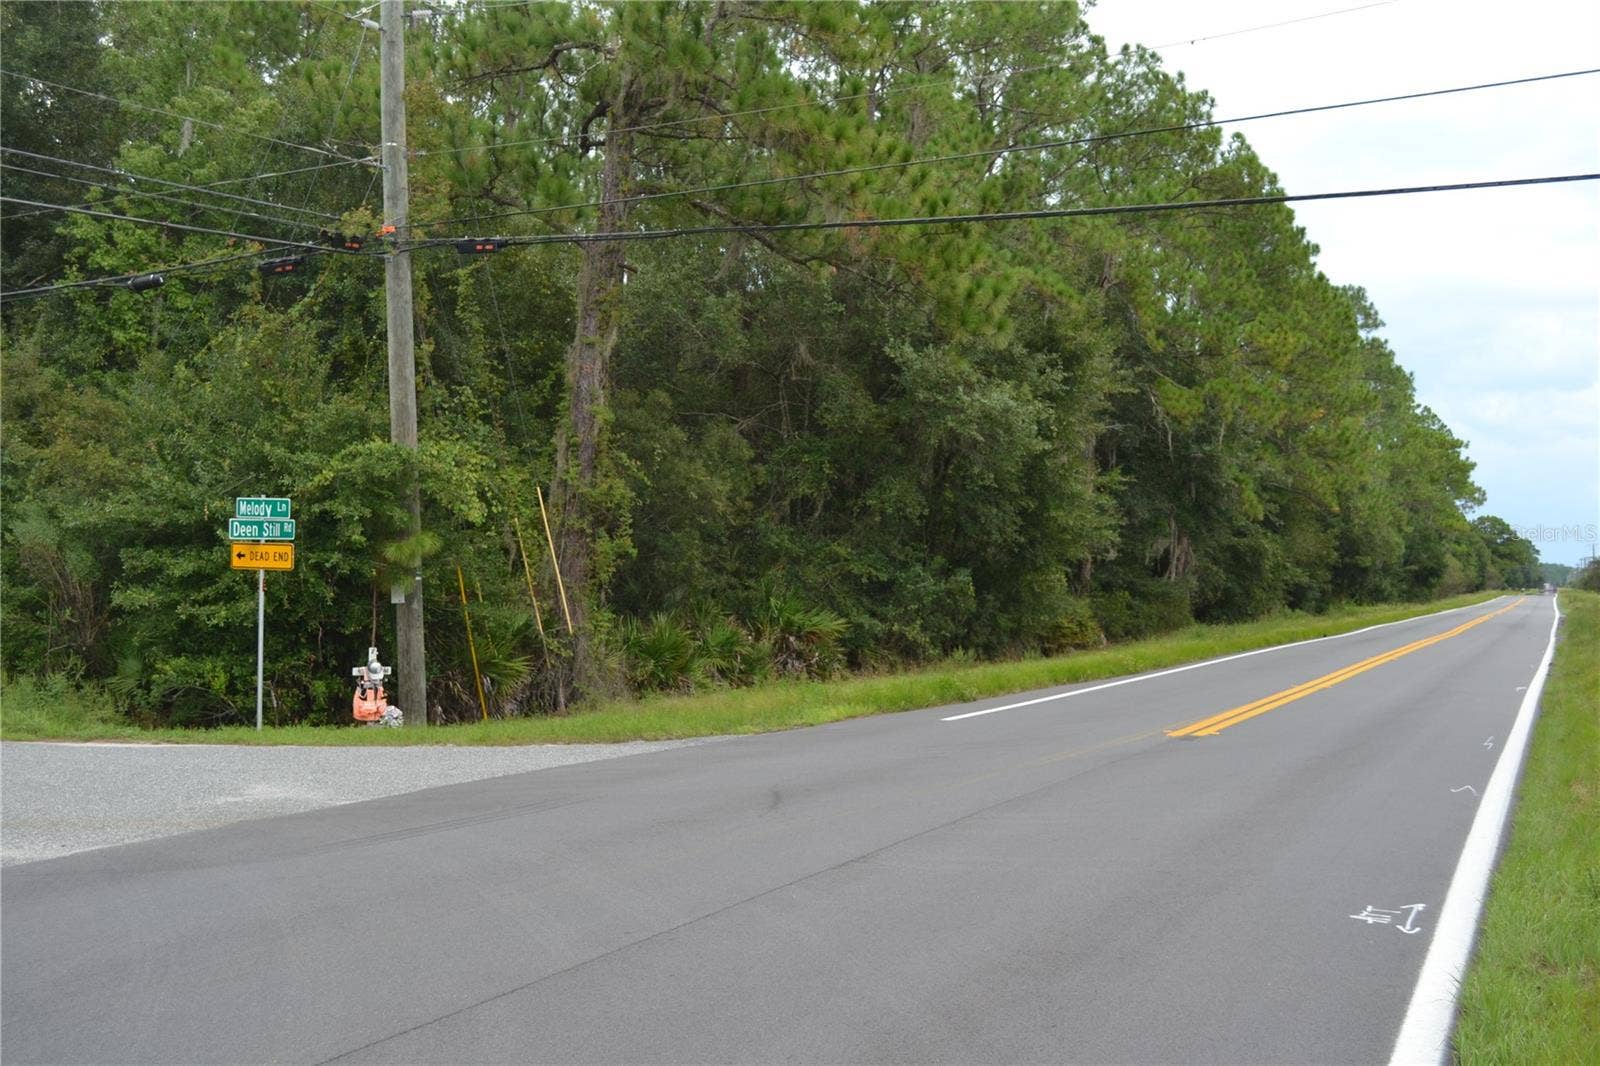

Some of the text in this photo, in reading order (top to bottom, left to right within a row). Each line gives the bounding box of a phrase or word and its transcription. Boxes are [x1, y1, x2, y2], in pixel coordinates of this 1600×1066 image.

[240, 501, 287, 518] Melody Ln
[233, 522, 292, 537] Deen Still Rd
[249, 551, 289, 561] DEAD END
